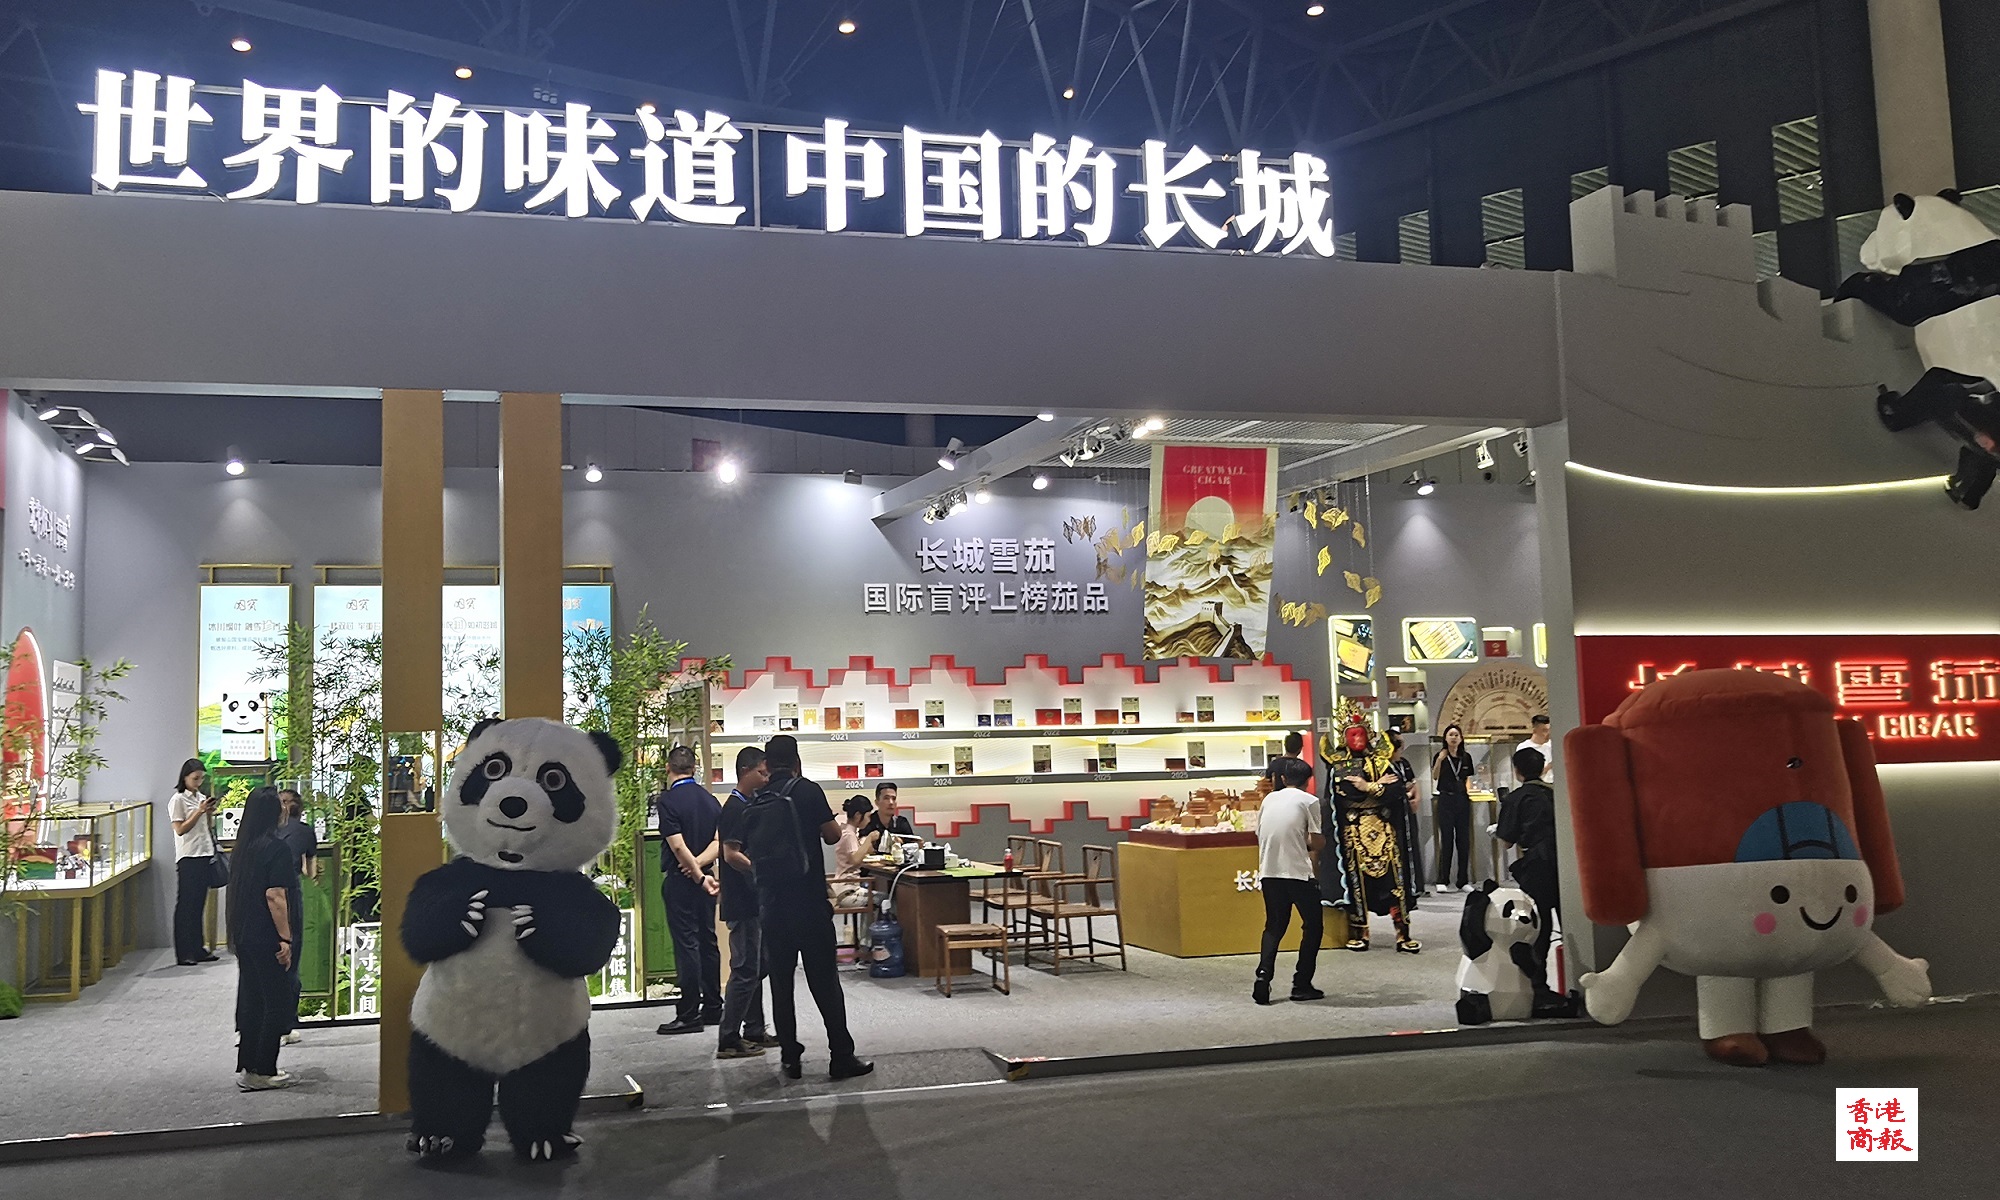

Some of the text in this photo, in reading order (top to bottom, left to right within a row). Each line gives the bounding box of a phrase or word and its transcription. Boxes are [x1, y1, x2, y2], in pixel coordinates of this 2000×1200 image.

[76, 66, 1336, 259] 世界的味道 中国的长城
[1197, 475, 1231, 485] CIGAR
[916, 537, 1056, 573] 长城雪茄
[863, 582, 1109, 613] 国际盲评上榜茄品
[830, 733, 849, 741] 2021
[845, 780, 865, 789] 2024
[933, 777, 953, 786] 2024
[358, 931, 378, 1014] 方寸之间
